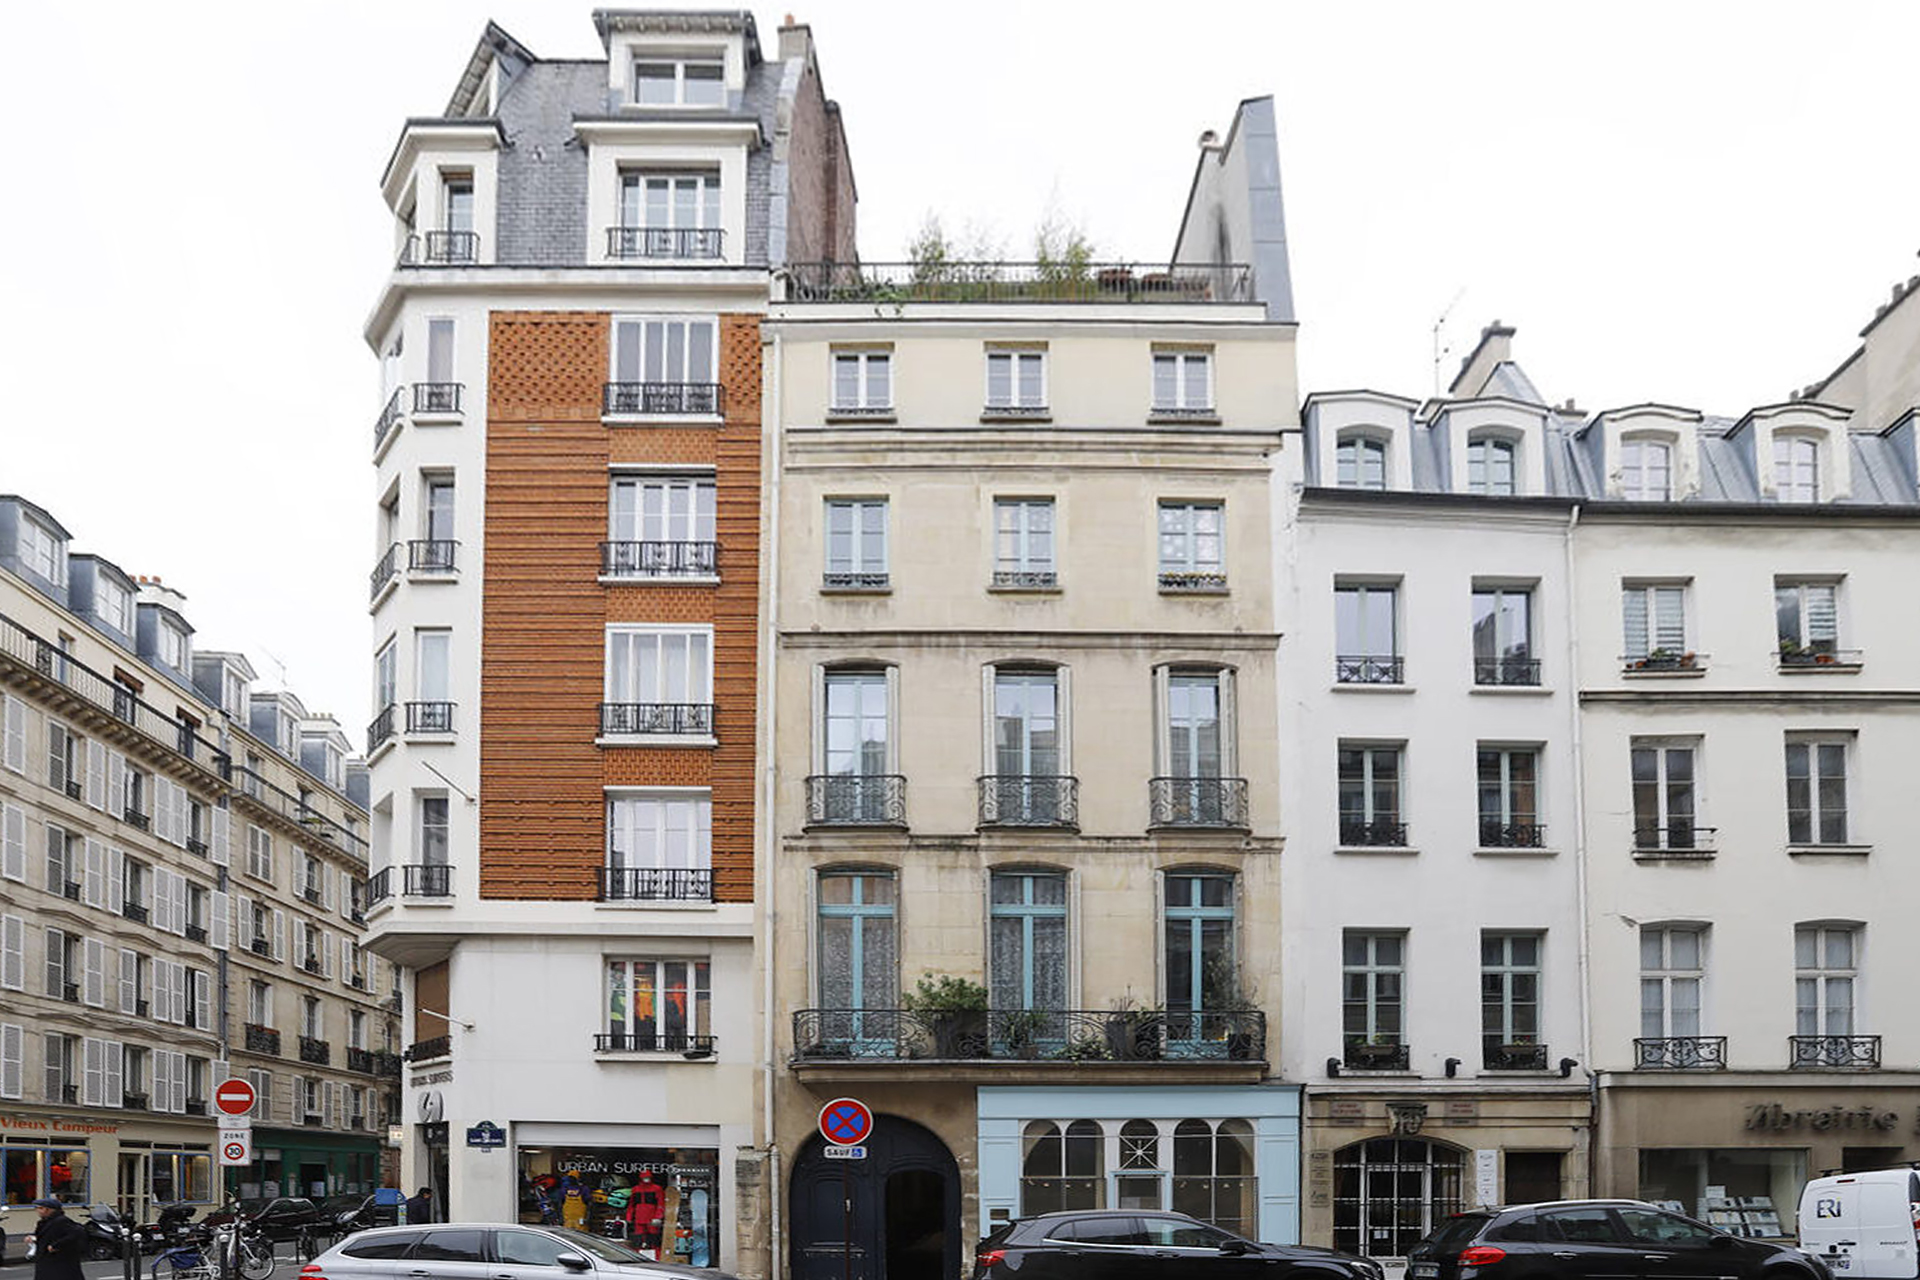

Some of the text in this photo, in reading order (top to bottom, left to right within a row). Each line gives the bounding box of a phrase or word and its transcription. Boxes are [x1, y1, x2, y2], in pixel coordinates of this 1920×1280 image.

[0, 1116, 118, 1134] Vieux Campeur
[229, 1147, 241, 1156] 30
[826, 1148, 850, 1157] SAUF
[557, 1161, 681, 1174] URBAN SURFERS
